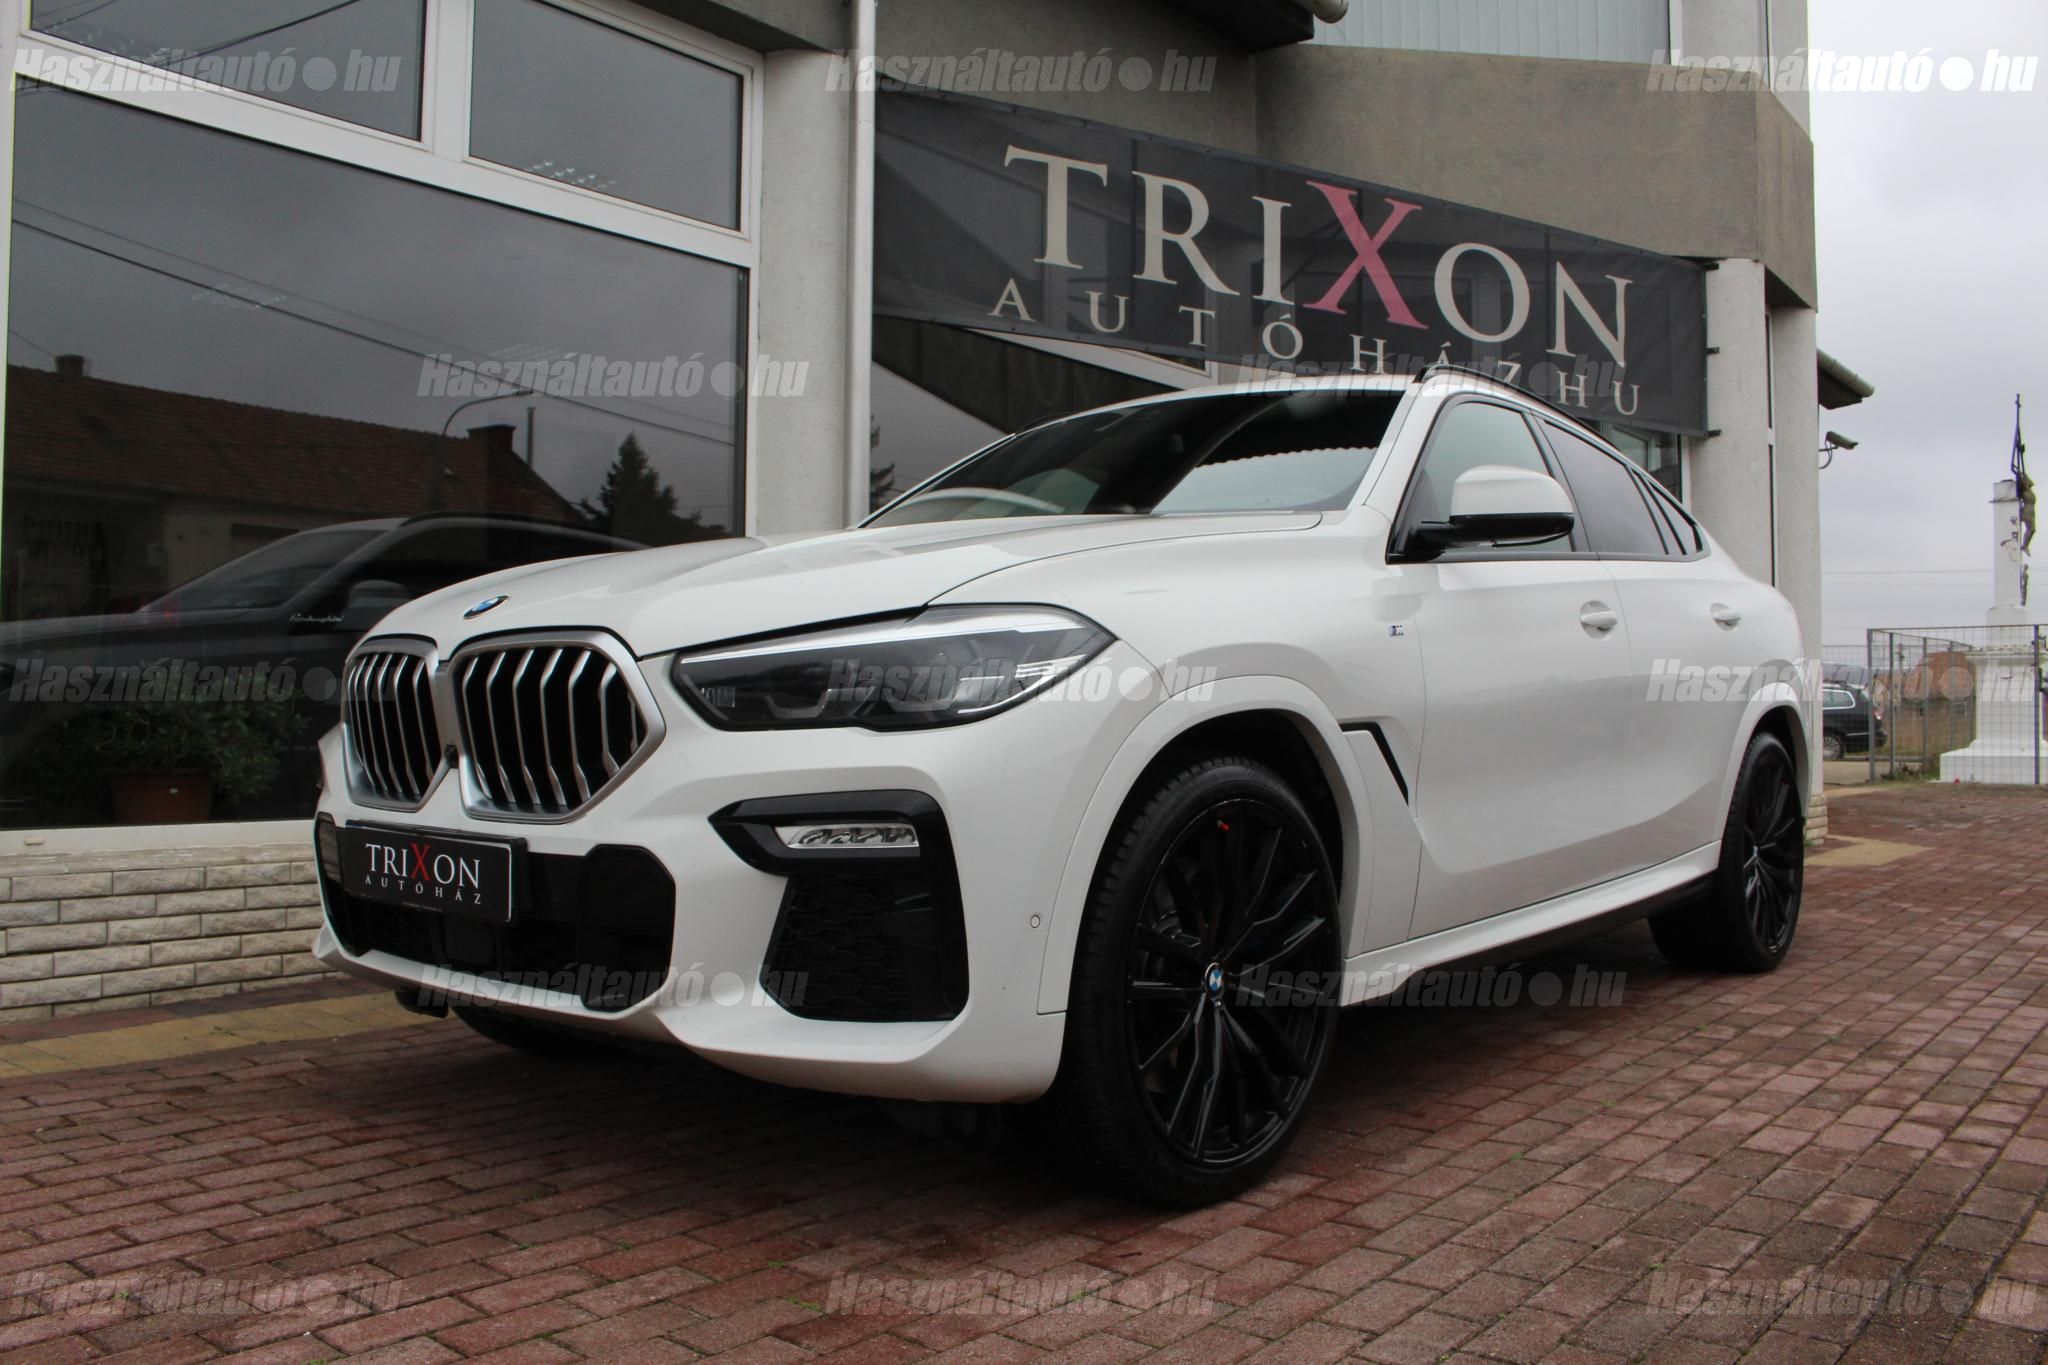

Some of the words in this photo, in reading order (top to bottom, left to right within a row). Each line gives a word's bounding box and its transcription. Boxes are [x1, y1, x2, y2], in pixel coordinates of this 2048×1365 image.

[1003, 144, 1633, 368] TRIXON
[365, 842, 481, 889] TRIXON
[364, 874, 482, 905] AUTÓHÁZ
